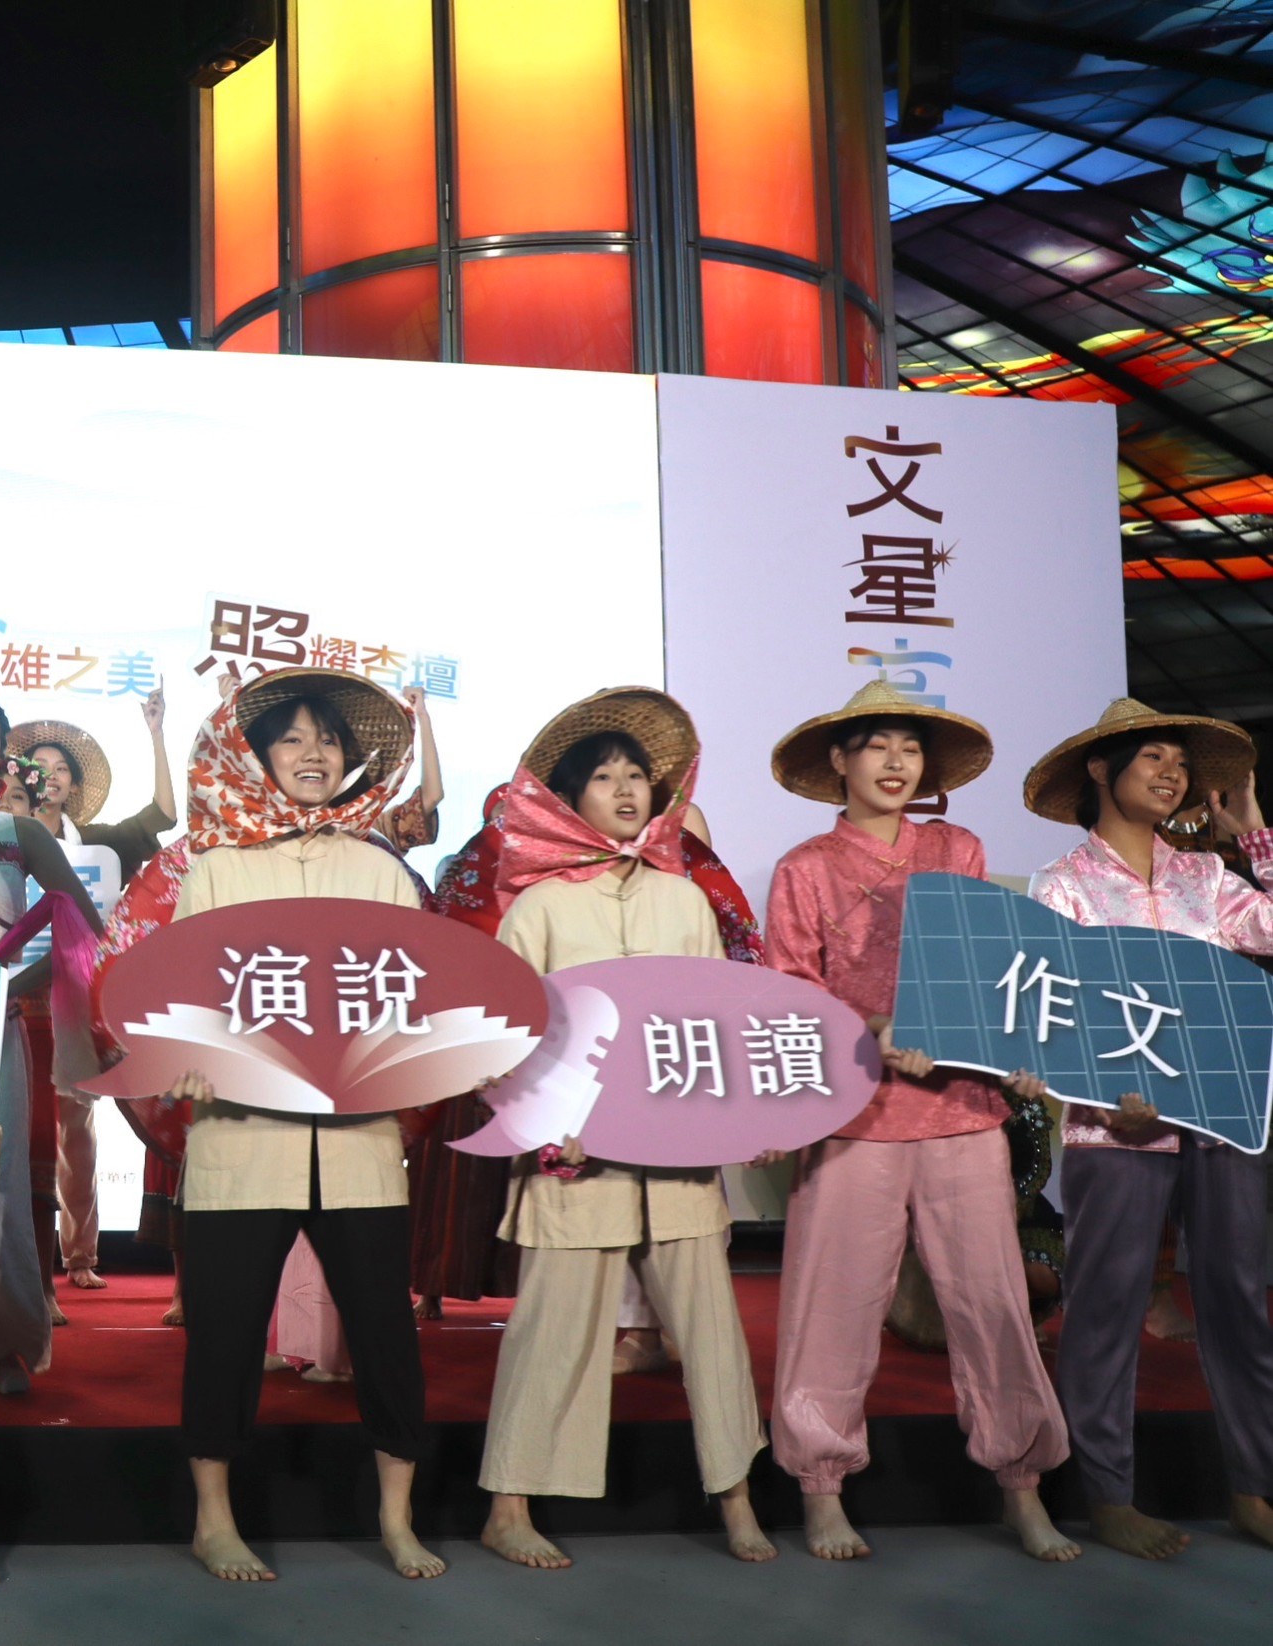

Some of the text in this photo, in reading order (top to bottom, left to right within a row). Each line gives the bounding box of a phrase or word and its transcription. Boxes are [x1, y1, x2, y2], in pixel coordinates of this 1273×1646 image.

[218, 945, 433, 1037] 演說
[995, 950, 1182, 1078] 作文
[643, 1012, 832, 1099] 朗讀
